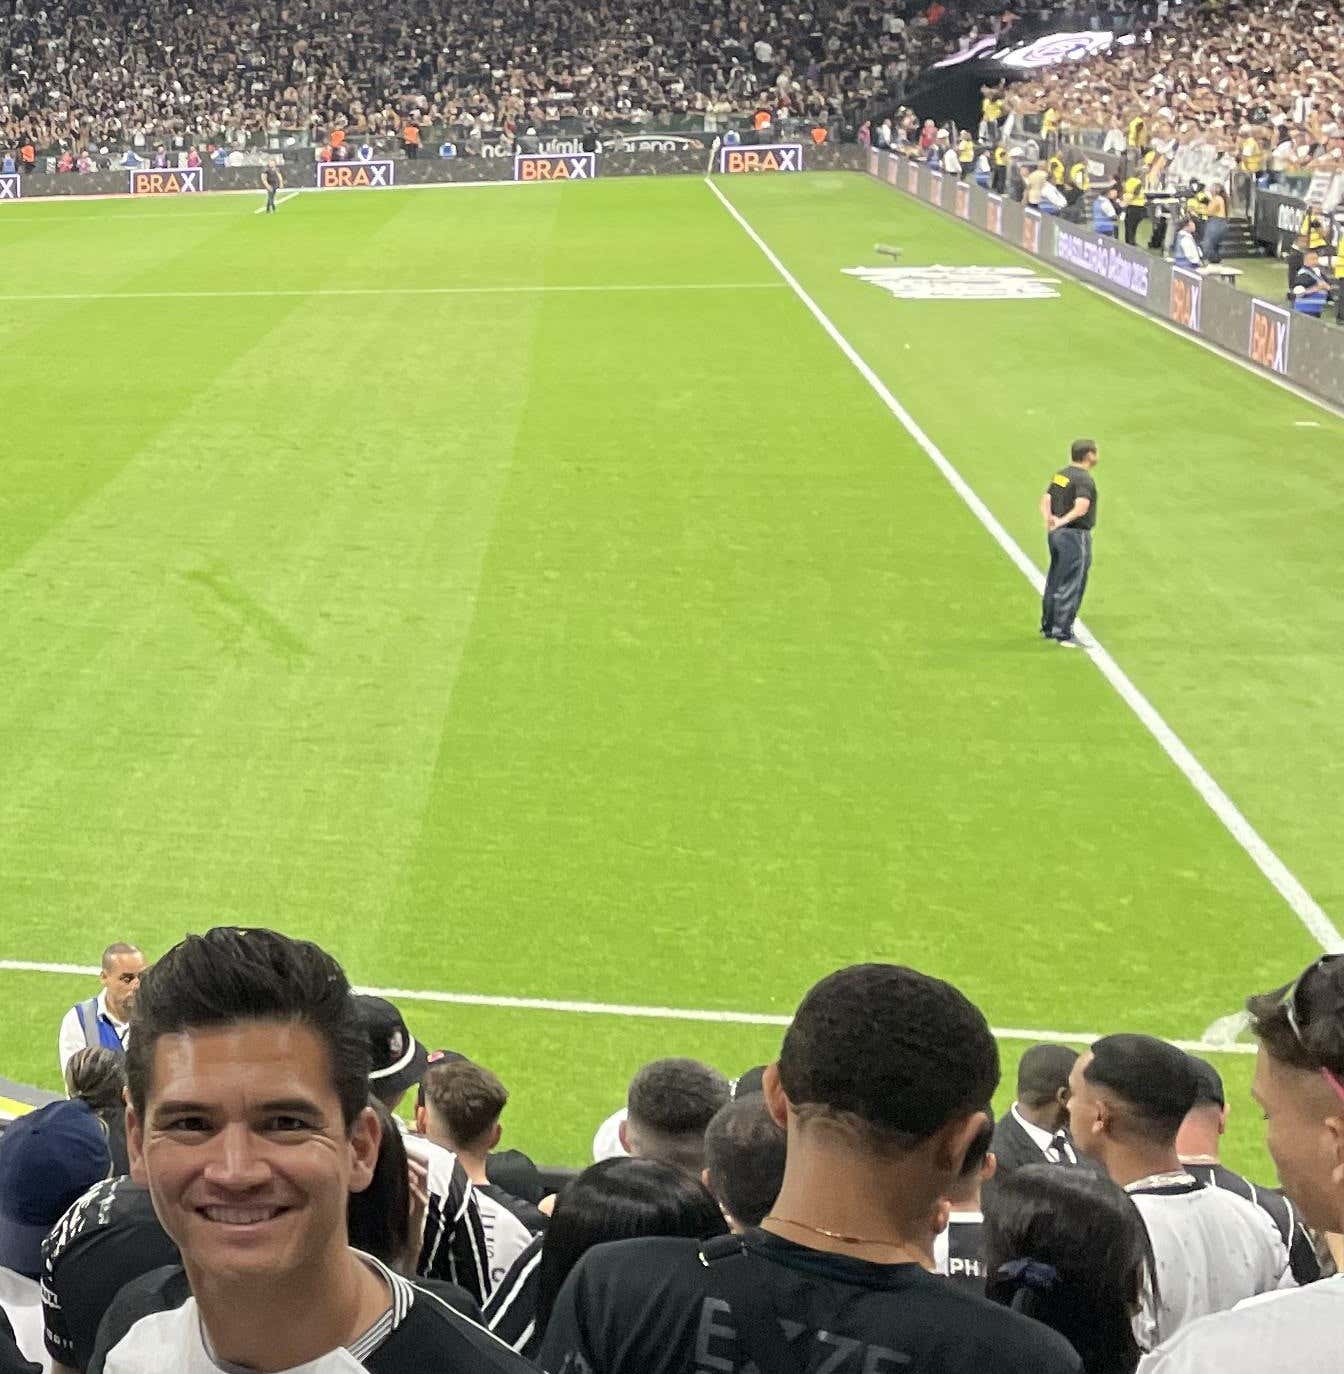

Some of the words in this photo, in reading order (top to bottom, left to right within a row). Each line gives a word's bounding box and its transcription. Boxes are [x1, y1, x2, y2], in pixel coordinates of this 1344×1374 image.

[522, 158, 588, 181] BRAX
[728, 149, 795, 172] BRAX
[136, 173, 196, 193] BRAX
[324, 165, 386, 187] BRAX
